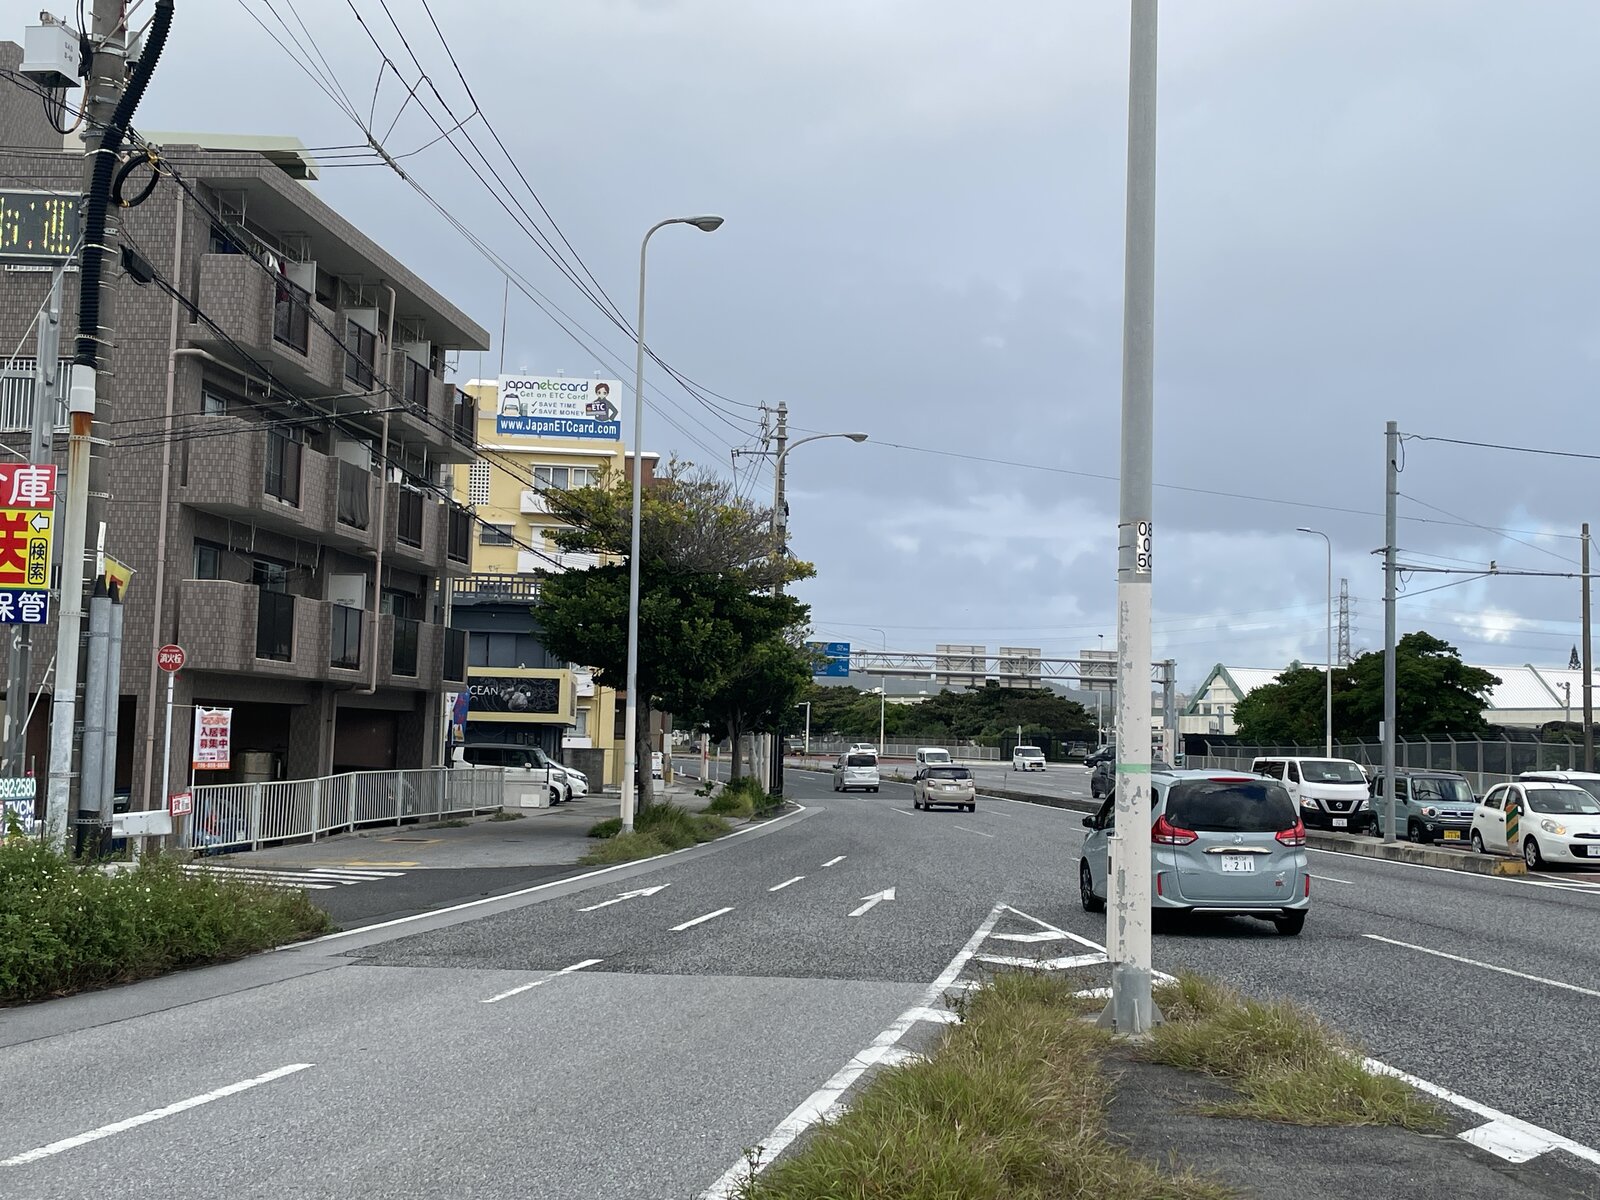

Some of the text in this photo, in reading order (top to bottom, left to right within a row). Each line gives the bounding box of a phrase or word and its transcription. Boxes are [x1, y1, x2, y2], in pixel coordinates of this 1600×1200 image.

[567, 393, 589, 401] Card!
[591, 403, 605, 411] ETC
[500, 419, 617, 435] www.JapanETCcard.com
[30, 542, 46, 580] 検索
[160, 653, 182, 664] 消火栓
[467, 685, 498, 696] CEAN
[201, 727, 228, 737] 入居者
[200, 739, 228, 749] 募集中
